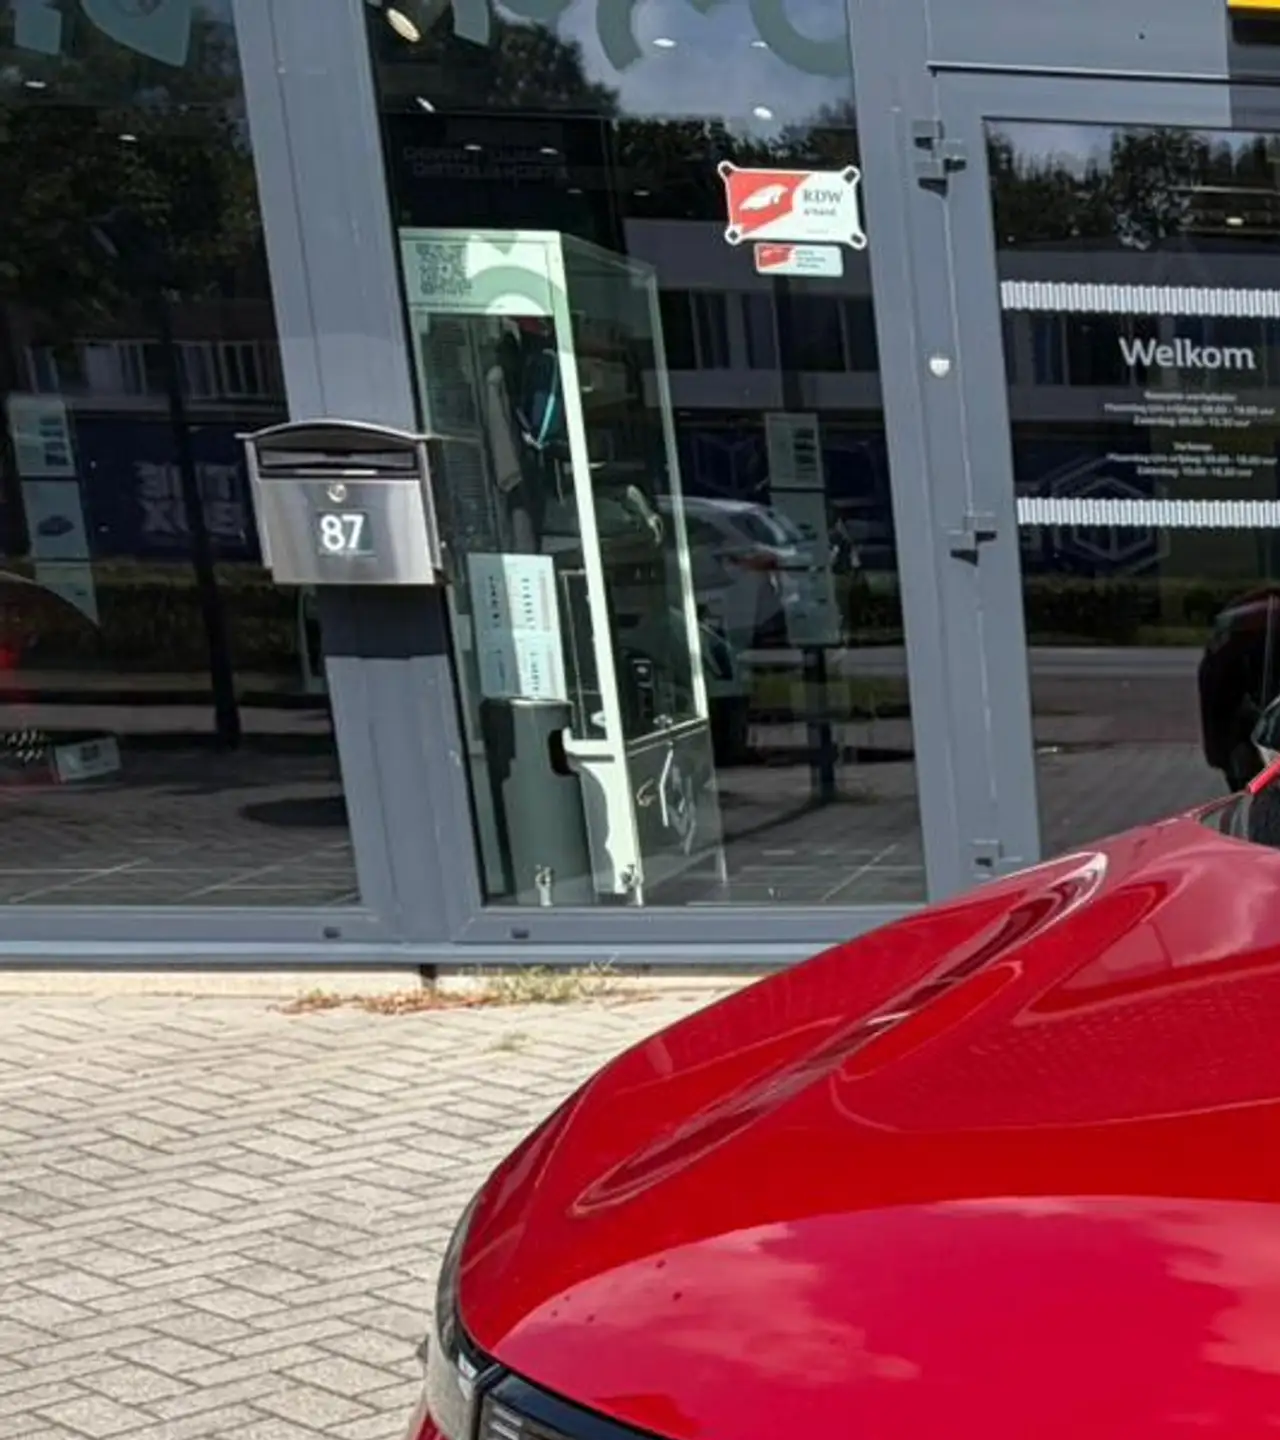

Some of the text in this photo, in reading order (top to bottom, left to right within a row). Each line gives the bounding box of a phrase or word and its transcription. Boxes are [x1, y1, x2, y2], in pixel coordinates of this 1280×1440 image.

[804, 189, 843, 203] RDW
[1118, 337, 1256, 369] Welkom
[321, 514, 363, 550] 87
